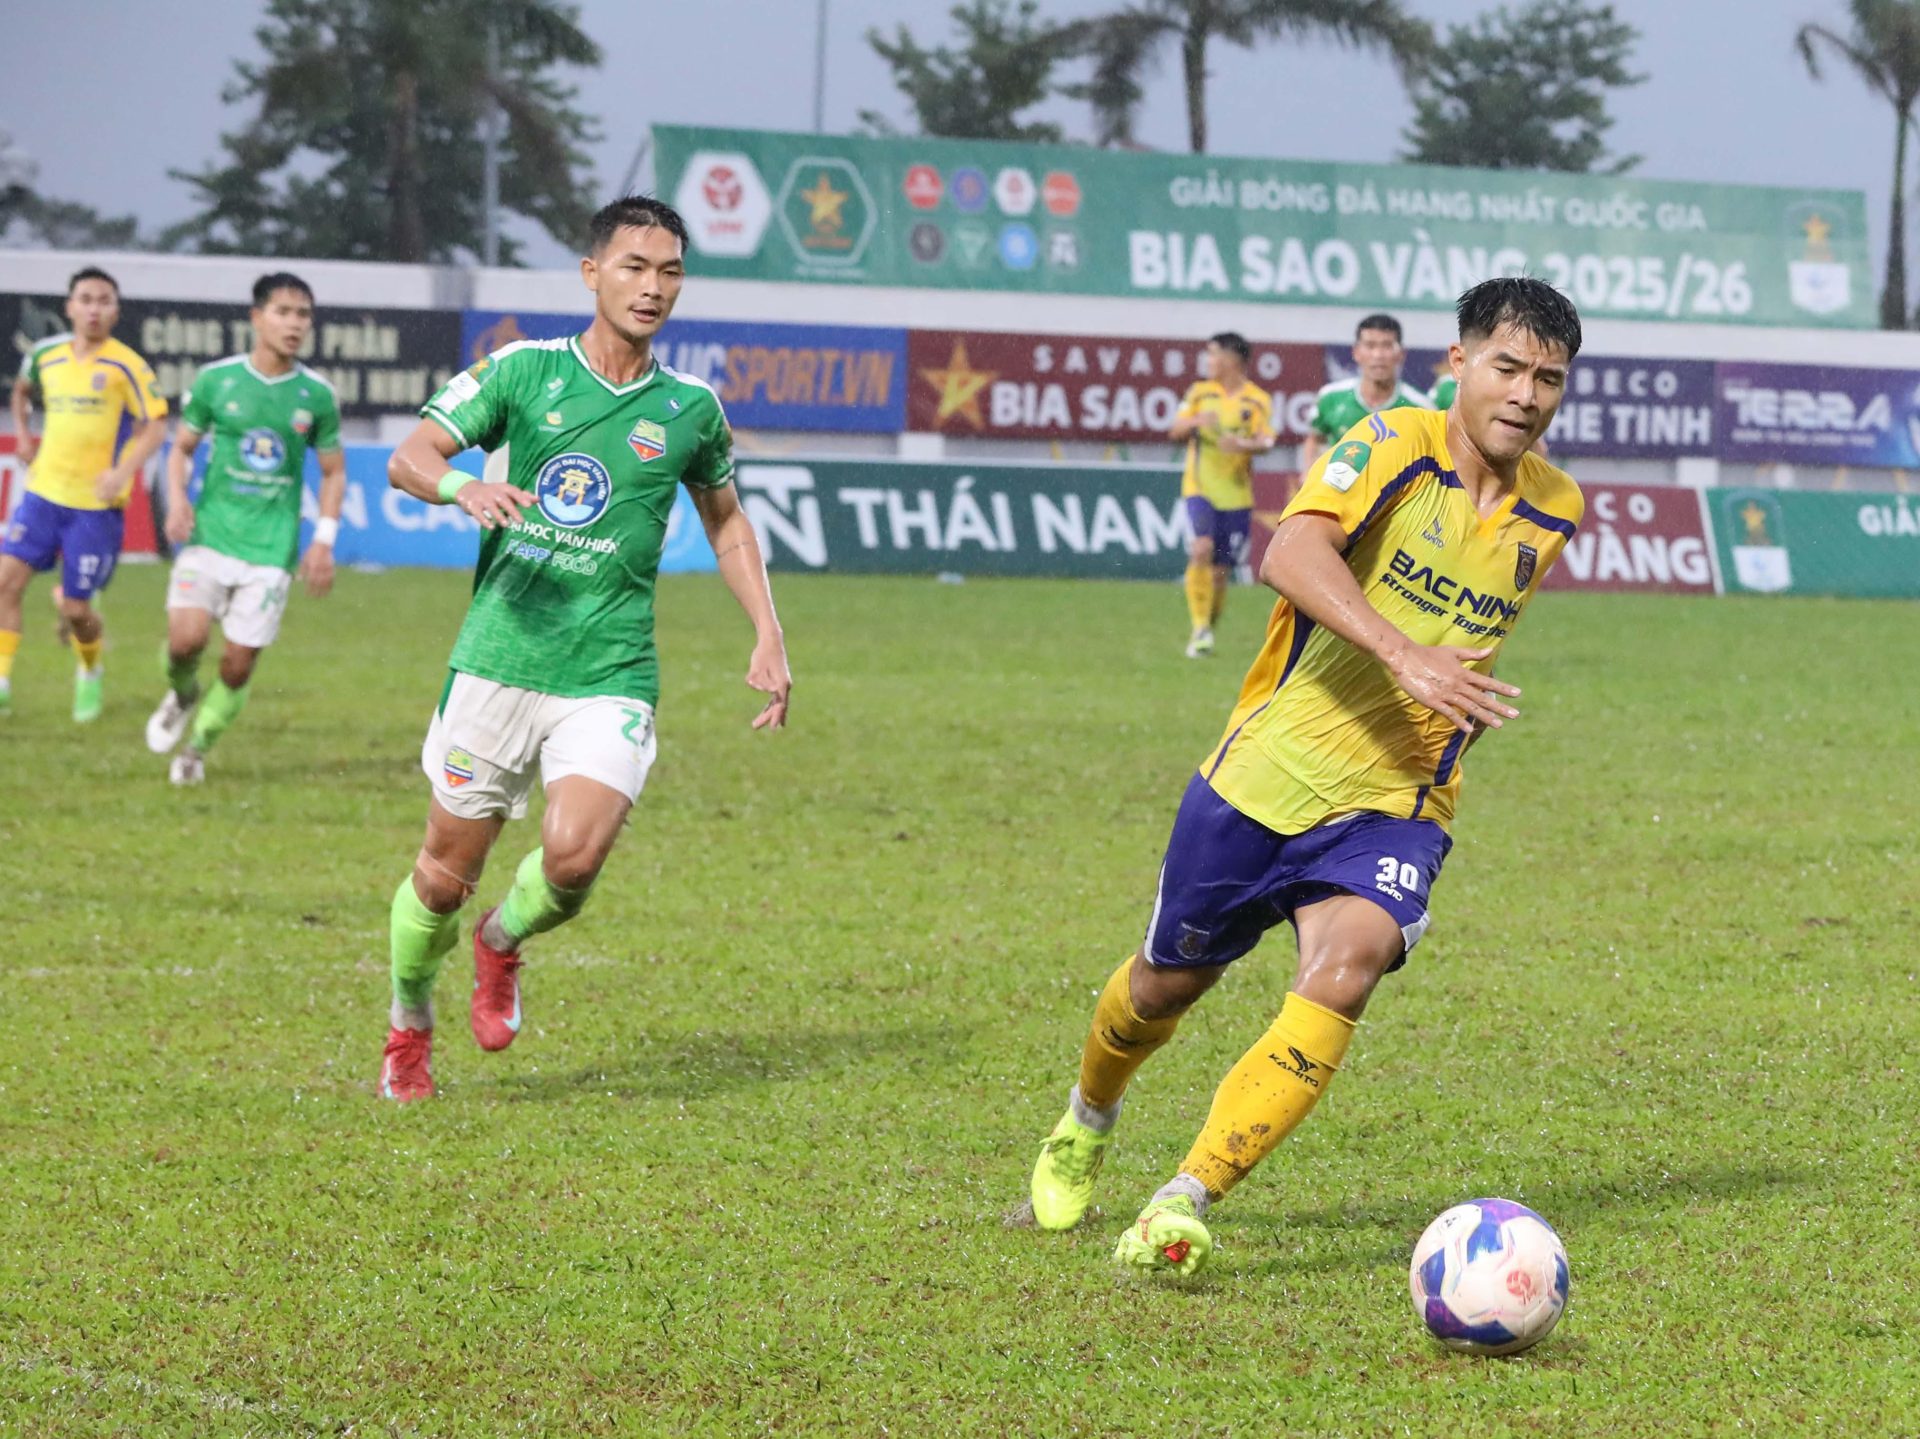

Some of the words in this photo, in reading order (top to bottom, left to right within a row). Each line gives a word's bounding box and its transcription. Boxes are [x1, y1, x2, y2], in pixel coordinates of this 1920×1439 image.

[1655, 200, 1708, 233] GIA
[1128, 229, 1230, 291] BIA
[1239, 235, 1361, 297] SAO
[1542, 251, 1753, 317] 2025/26
[990, 381, 1072, 430] BIA
[1079, 384, 1179, 432] SAO
[523, 521, 553, 540] HỌC
[838, 475, 1017, 552] THÁI
[1031, 492, 1195, 556] NAM
[1563, 523, 1711, 585] VÀNG
[1379, 572, 1448, 617] Stronger
[1389, 548, 1457, 603] BAC
[1454, 586, 1523, 623] NINH
[1375, 856, 1420, 893] 30
